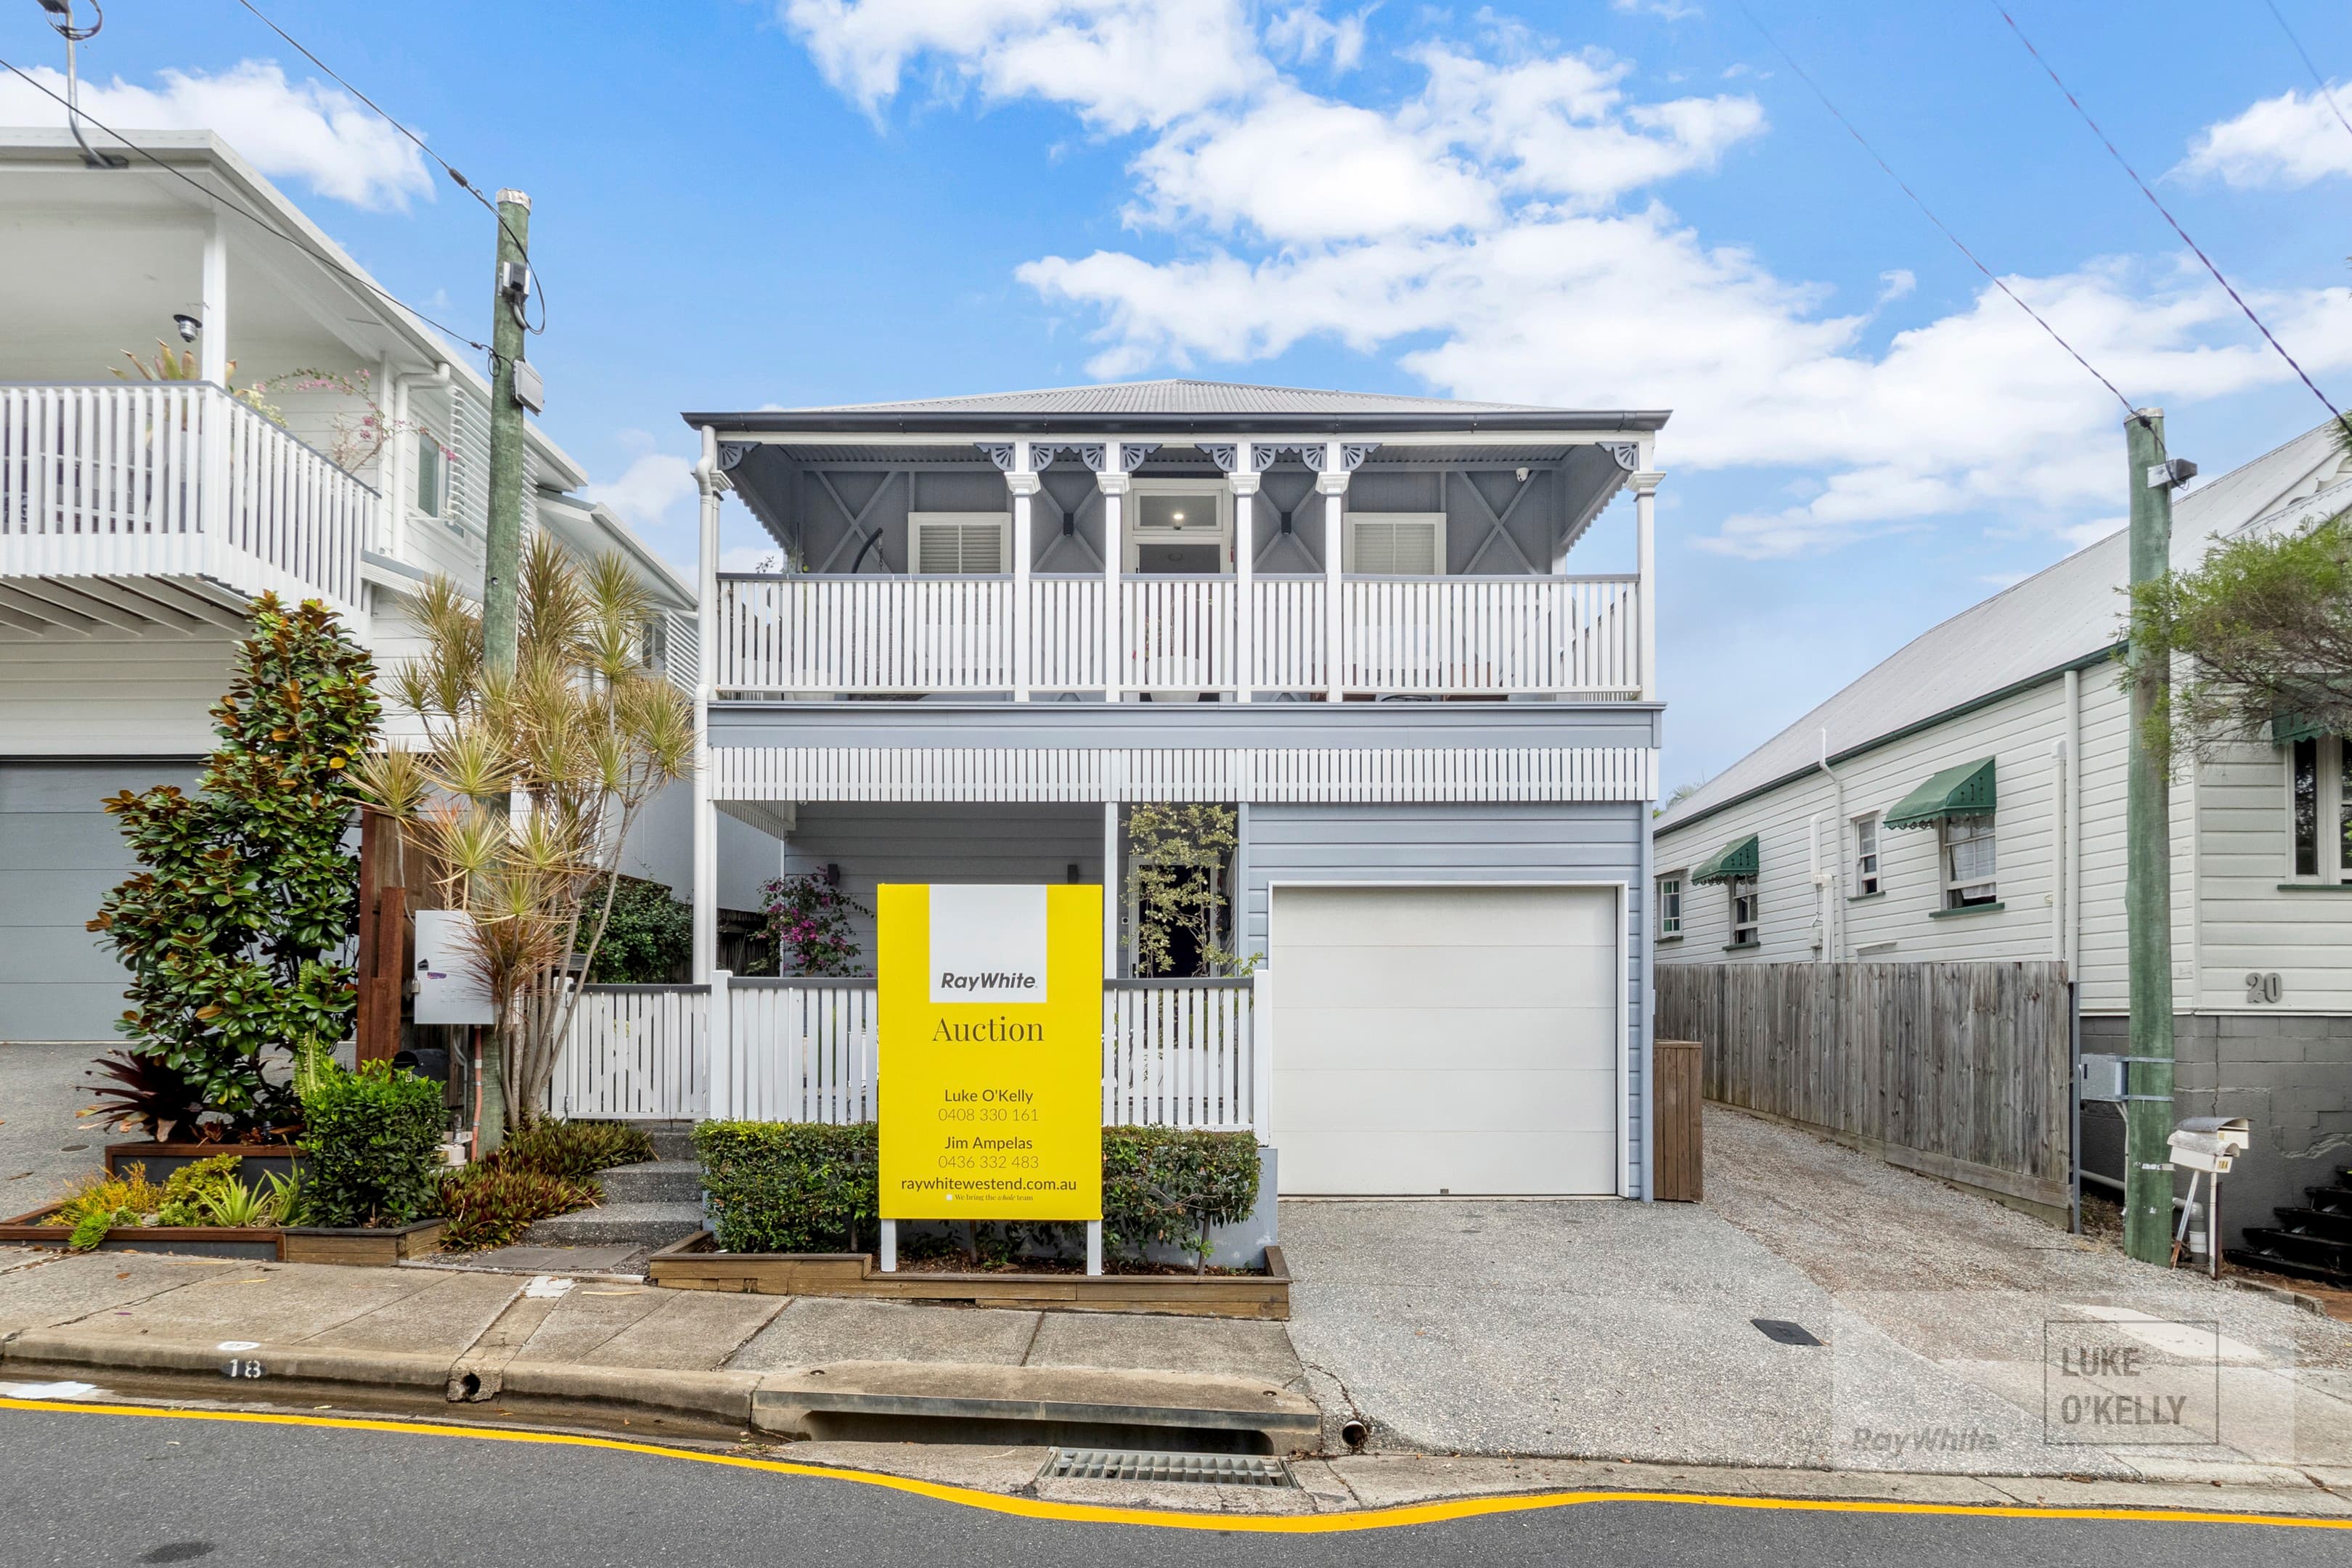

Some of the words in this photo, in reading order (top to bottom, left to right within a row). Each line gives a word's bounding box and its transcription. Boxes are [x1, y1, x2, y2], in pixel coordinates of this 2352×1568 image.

[2245, 972, 2282, 1003] 20
[932, 1016, 1045, 1042] Auction
[944, 1090, 978, 1102] Luke
[982, 1089, 1034, 1104] O'Kelly
[938, 1108, 975, 1122] 0408
[980, 1108, 1007, 1122] 330
[1013, 1108, 1039, 1122] 161
[944, 1137, 968, 1149] Jim
[973, 1136, 1033, 1151] Ampelas
[938, 1156, 975, 1169] 0436
[980, 1156, 1006, 1169] 332
[1011, 1156, 1039, 1169] 483
[902, 1177, 1077, 1192] raywhitewestend.com.au
[229, 1358, 261, 1379] 18
